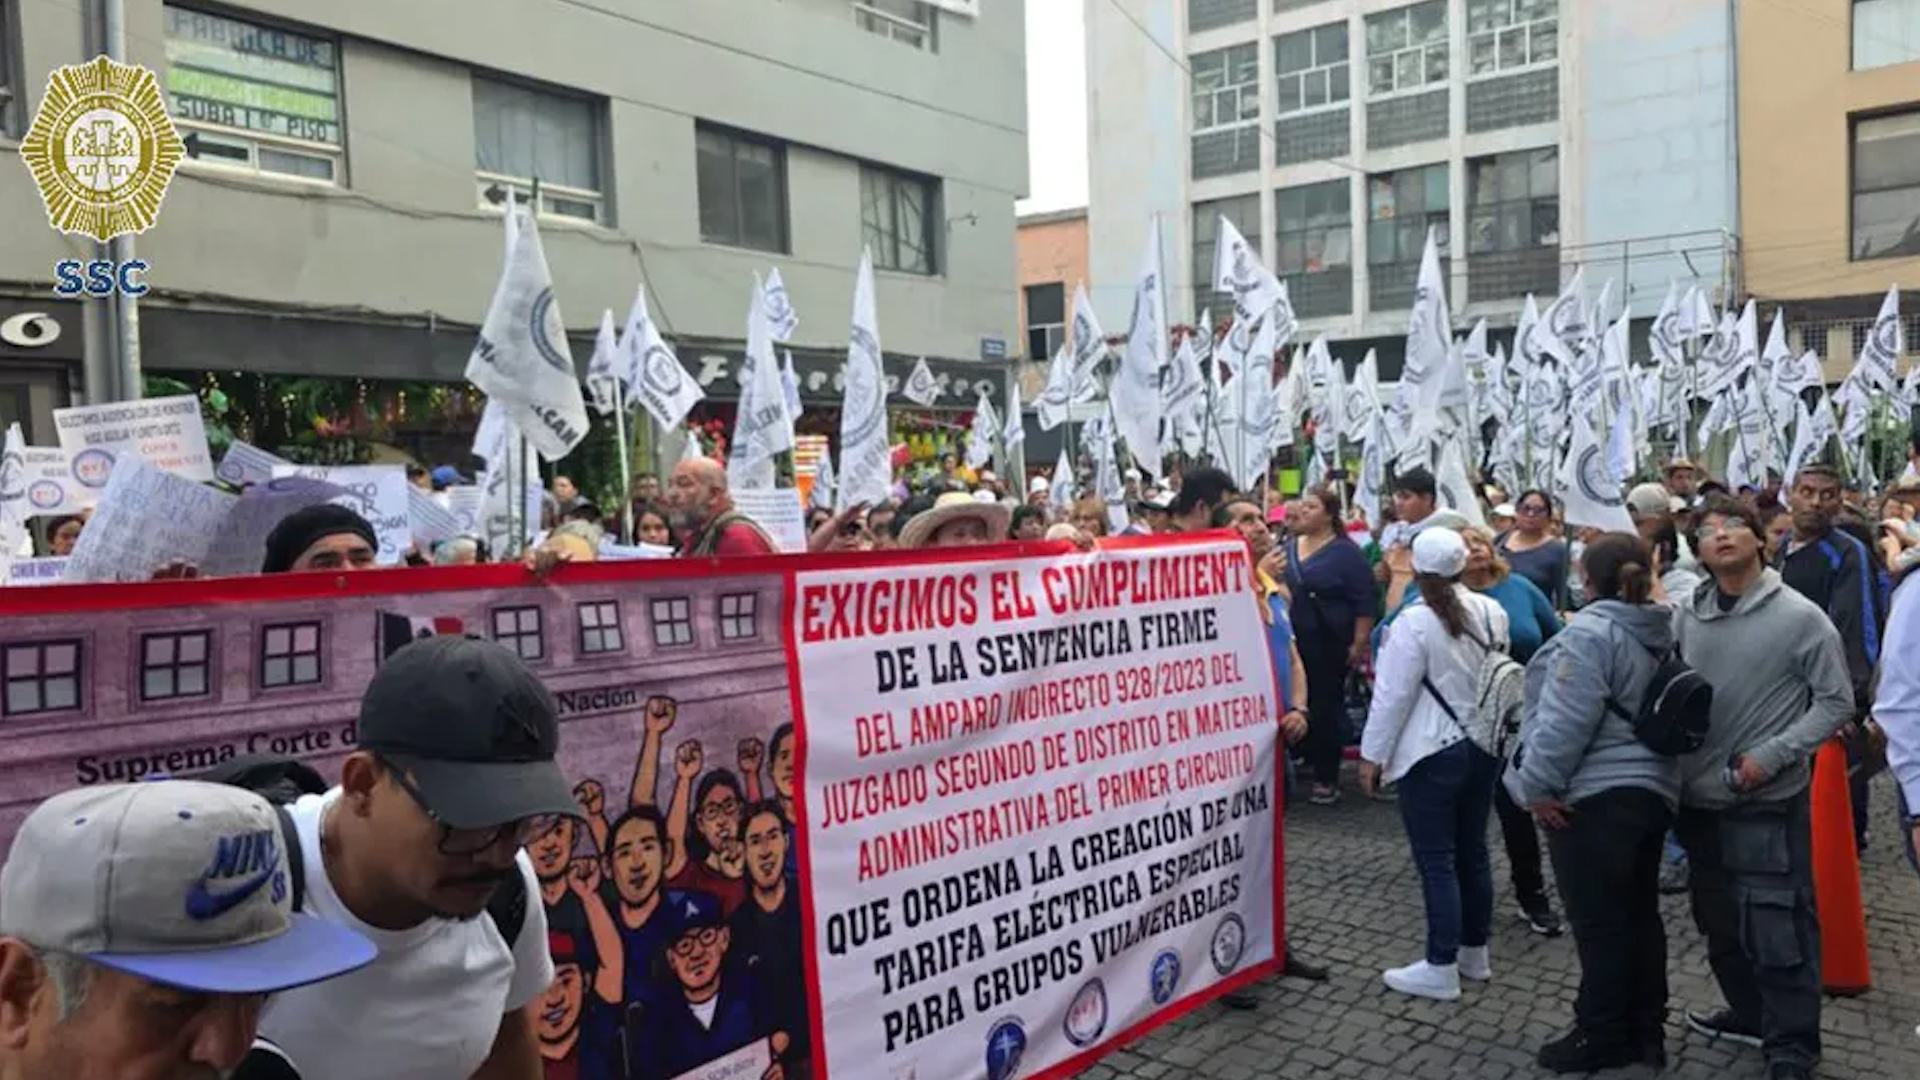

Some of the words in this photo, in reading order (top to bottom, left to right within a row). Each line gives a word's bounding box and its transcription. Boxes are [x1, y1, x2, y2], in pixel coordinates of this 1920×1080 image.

[177, 97, 235, 126] SUBA
[287, 115, 326, 142] PISO
[802, 573, 978, 643] EXIGIMOS
[991, 570, 1036, 621] EL
[875, 646, 919, 693] DE
[928, 641, 968, 685] LA
[976, 618, 1132, 677] SENTENCIA
[1140, 607, 1218, 650] FIRME
[76, 742, 236, 784] Suprema
[247, 731, 331, 756] Corte
[821, 764, 928, 829] JUZGADO
[935, 740, 1036, 797] SEGUNDO
[1043, 733, 1069, 771] DE
[1074, 715, 1161, 764] DISTRITO
[1166, 709, 1190, 744] EN
[1195, 694, 1269, 736] MATERIA
[855, 711, 902, 757] DEL
[910, 692, 1001, 747] AMPARO
[1007, 673, 1110, 725] INDIRECTO
[1116, 658, 1206, 703] 928/2023
[1211, 652, 1243, 686] DEL
[827, 897, 892, 956] QUE
[903, 857, 1022, 928] ORDENA
[1029, 844, 1064, 886] LA
[1071, 802, 1193, 872] CREACIÓN
[1200, 796, 1228, 833] DE
[1231, 783, 1269, 820] UNA
[858, 792, 1049, 883] ADMINISTRATIVA
[1054, 782, 1093, 824] DEL
[1098, 762, 1171, 811] PRIMER
[1175, 743, 1254, 791] CIRCUITO
[875, 922, 985, 996] TARIFA
[993, 871, 1142, 951] ELÉCTRICA
[1148, 832, 1245, 896] ESPECIAL
[883, 986, 965, 1053] PARA
[974, 939, 1083, 1013] GRUPOS
[1090, 872, 1241, 965] VULNERABLES
